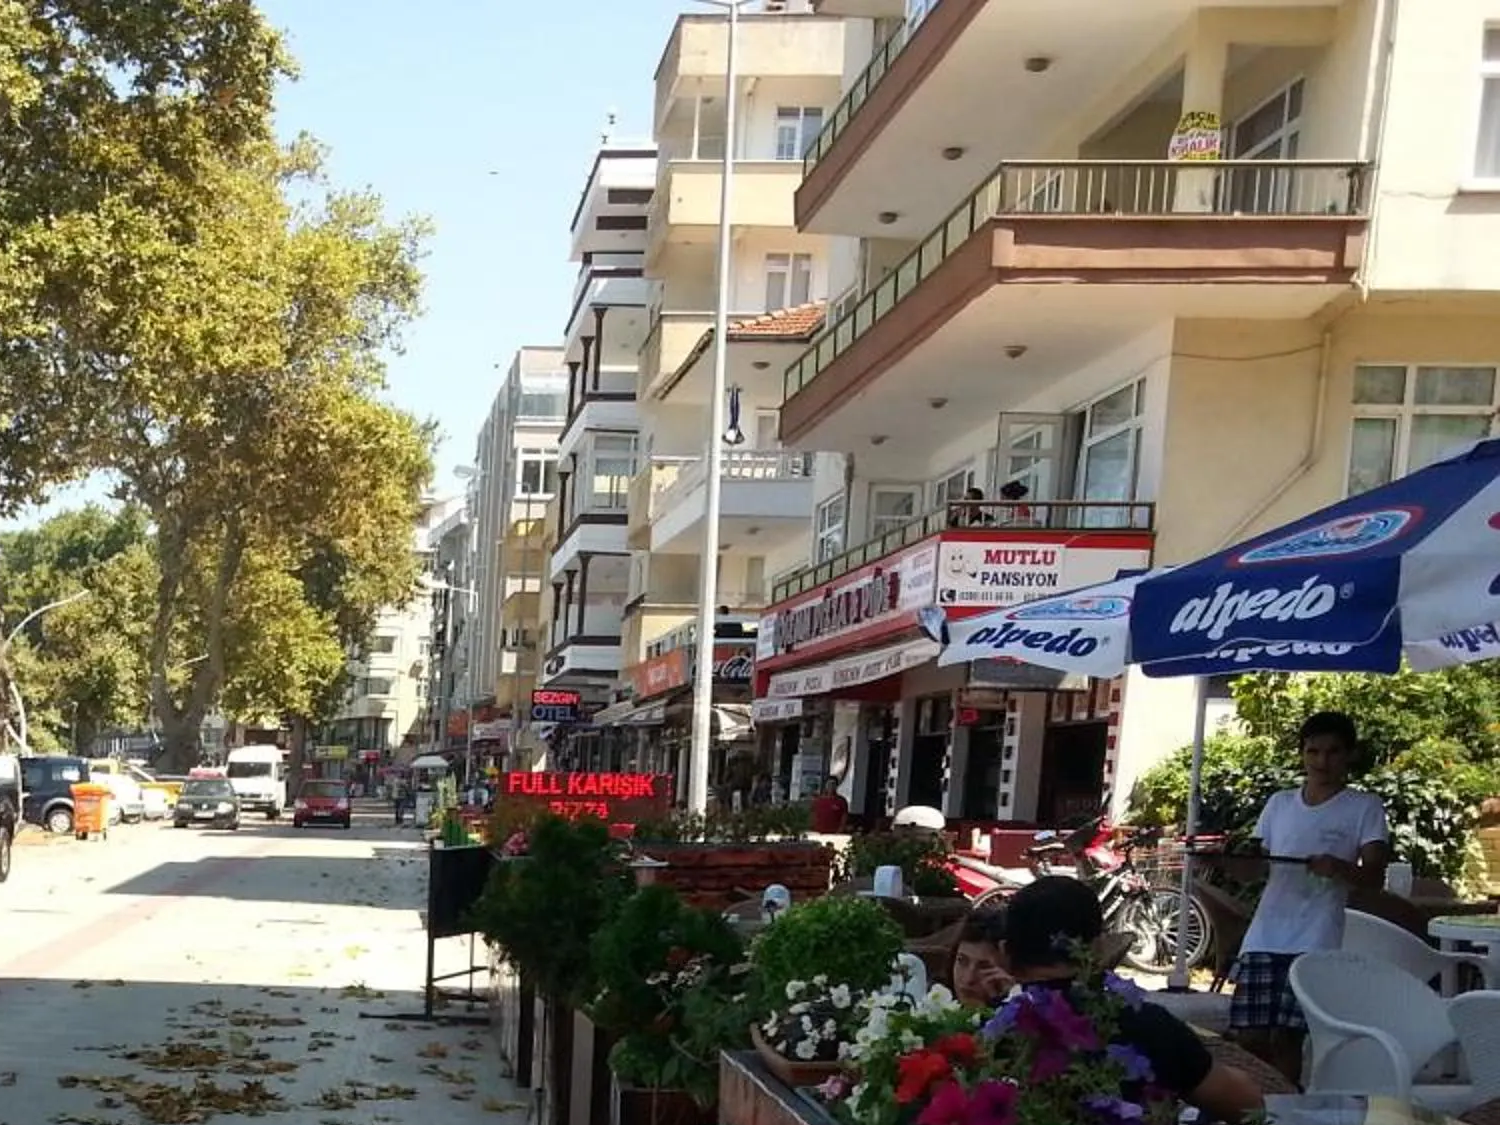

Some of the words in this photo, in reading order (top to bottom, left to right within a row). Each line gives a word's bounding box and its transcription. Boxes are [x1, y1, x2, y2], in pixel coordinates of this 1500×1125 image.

[984, 549, 1056, 565] MUTLU
[1169, 575, 1335, 640] alpedo
[966, 622, 1098, 657] alpedo
[532, 705, 576, 720] OTEL
[508, 772, 563, 794] FULL
[567, 772, 655, 800] KARIŞIK
